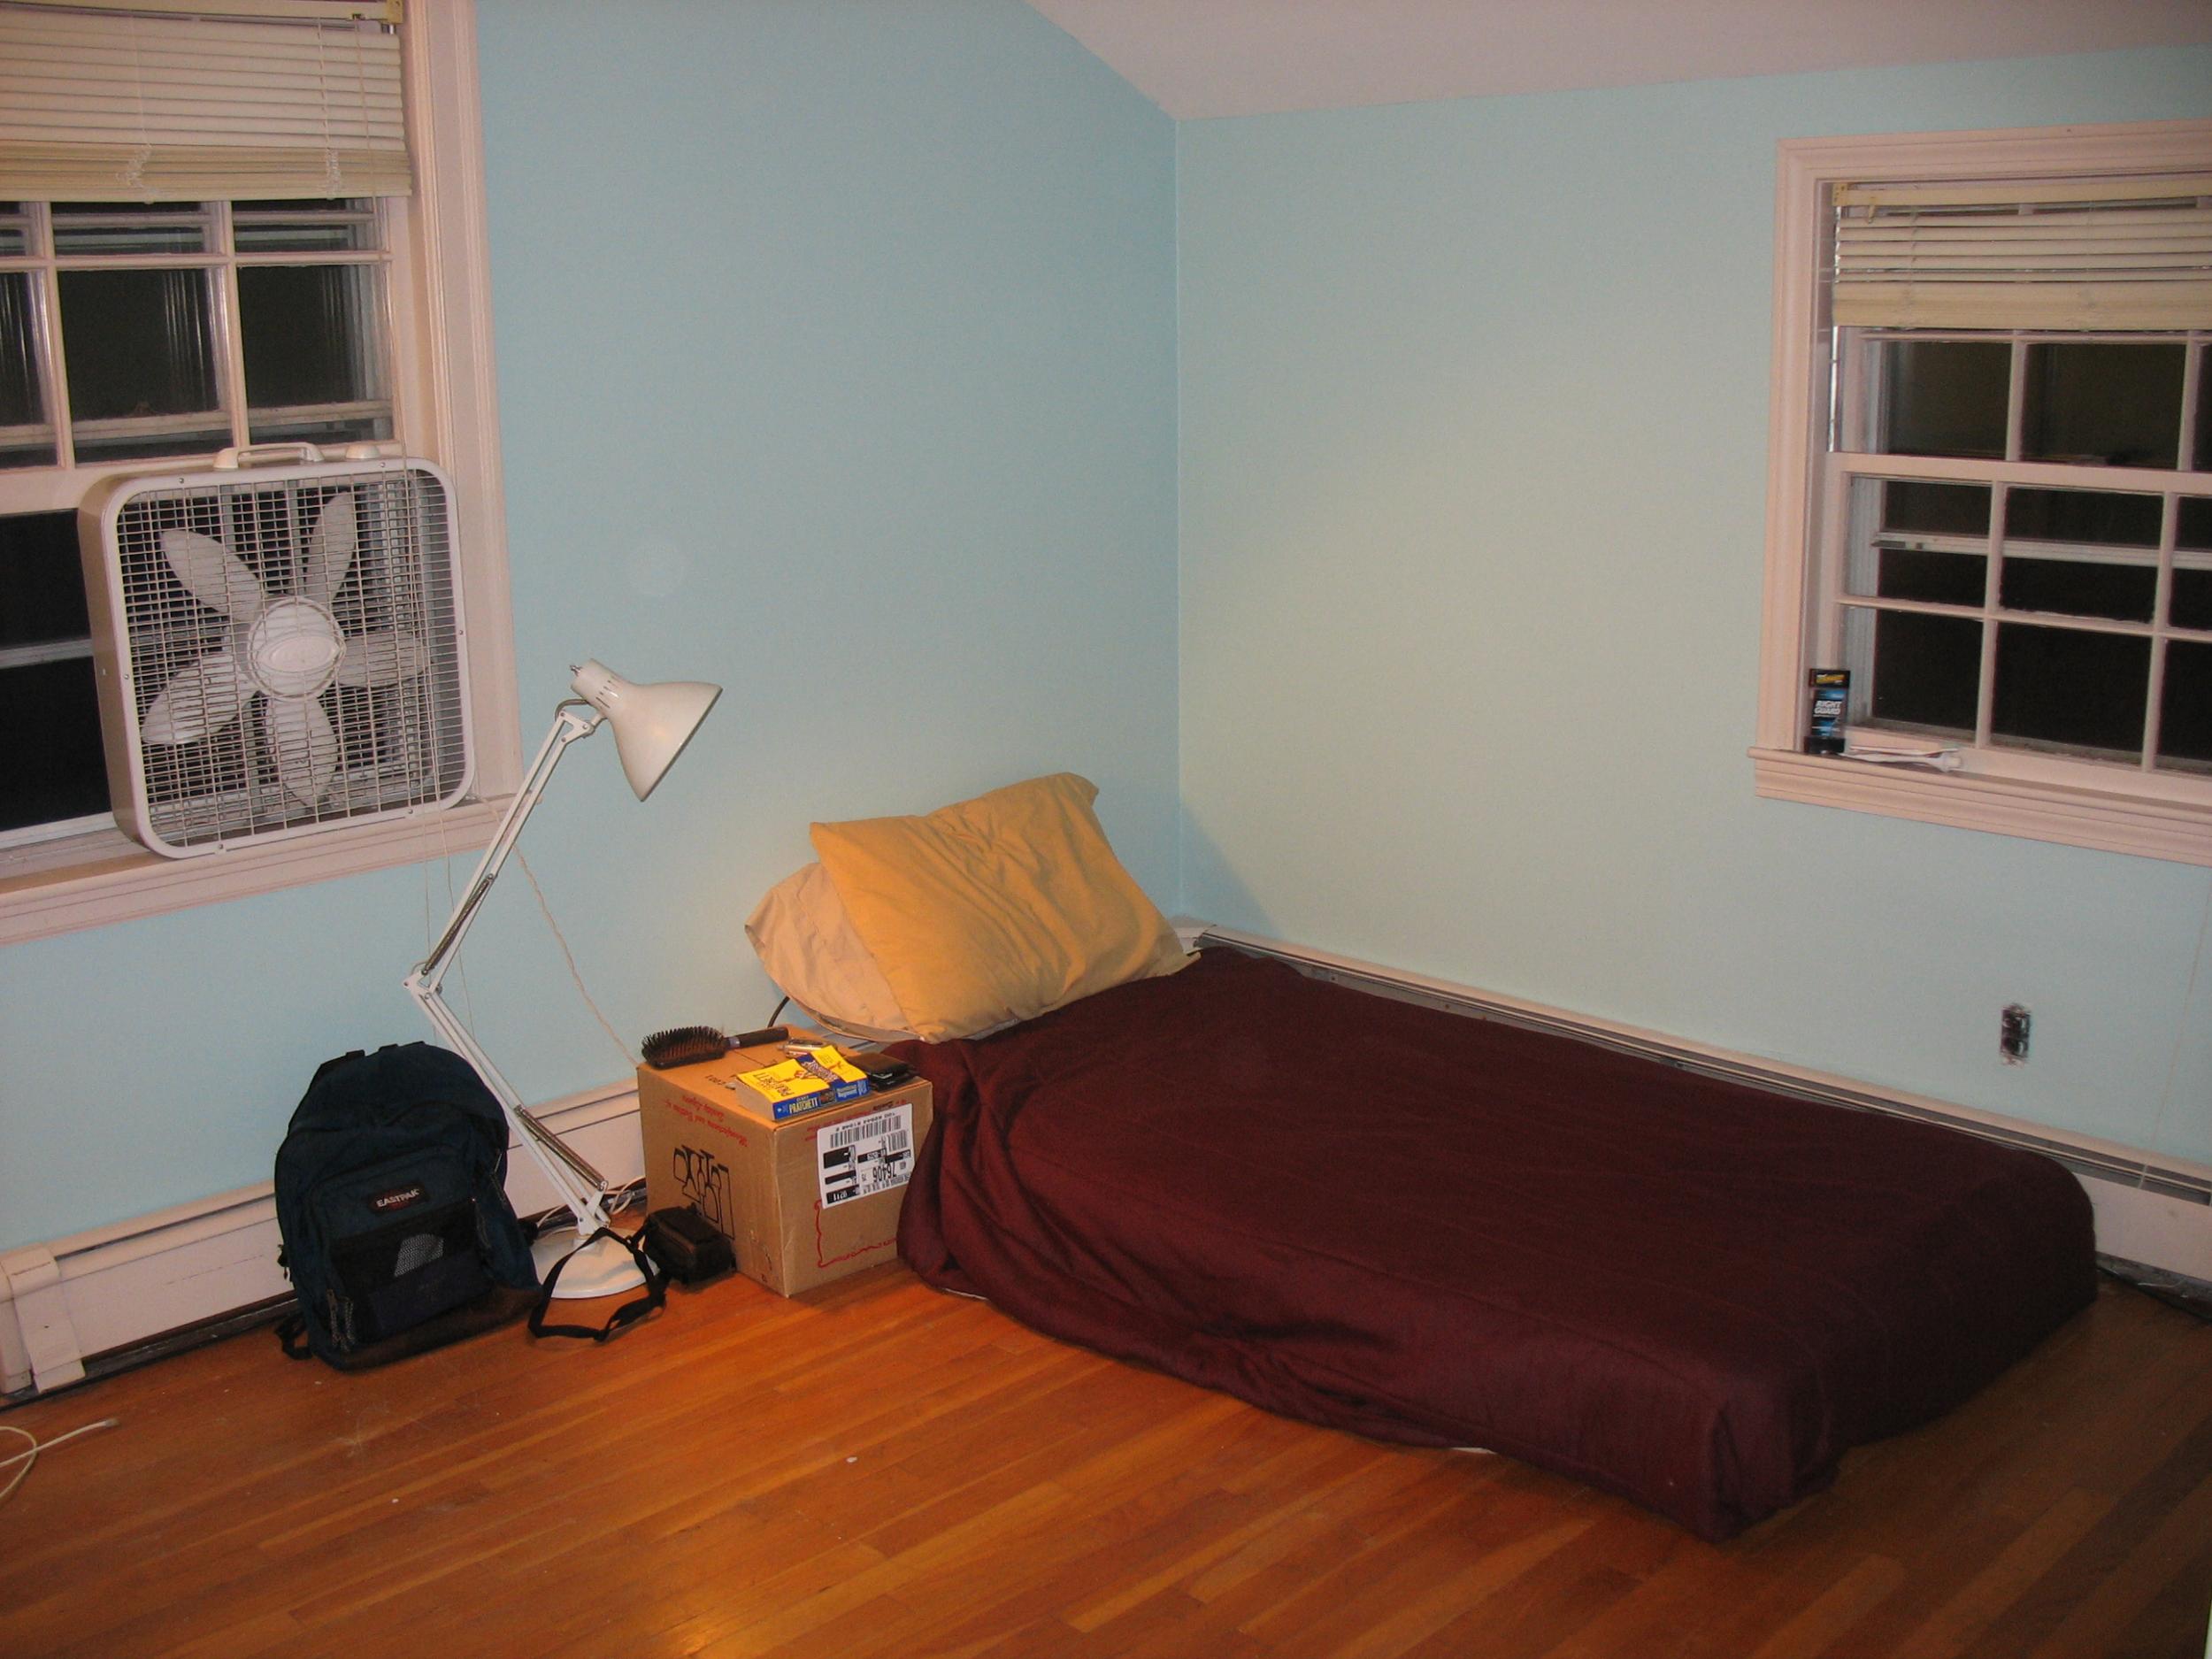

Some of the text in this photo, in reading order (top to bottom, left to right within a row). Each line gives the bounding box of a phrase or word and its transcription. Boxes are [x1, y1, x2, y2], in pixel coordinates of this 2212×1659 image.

[788, 1097, 818, 1114] PRATCHETT
[872, 1160, 897, 1183] 76406
[376, 1188, 420, 1207] EASTPAK
